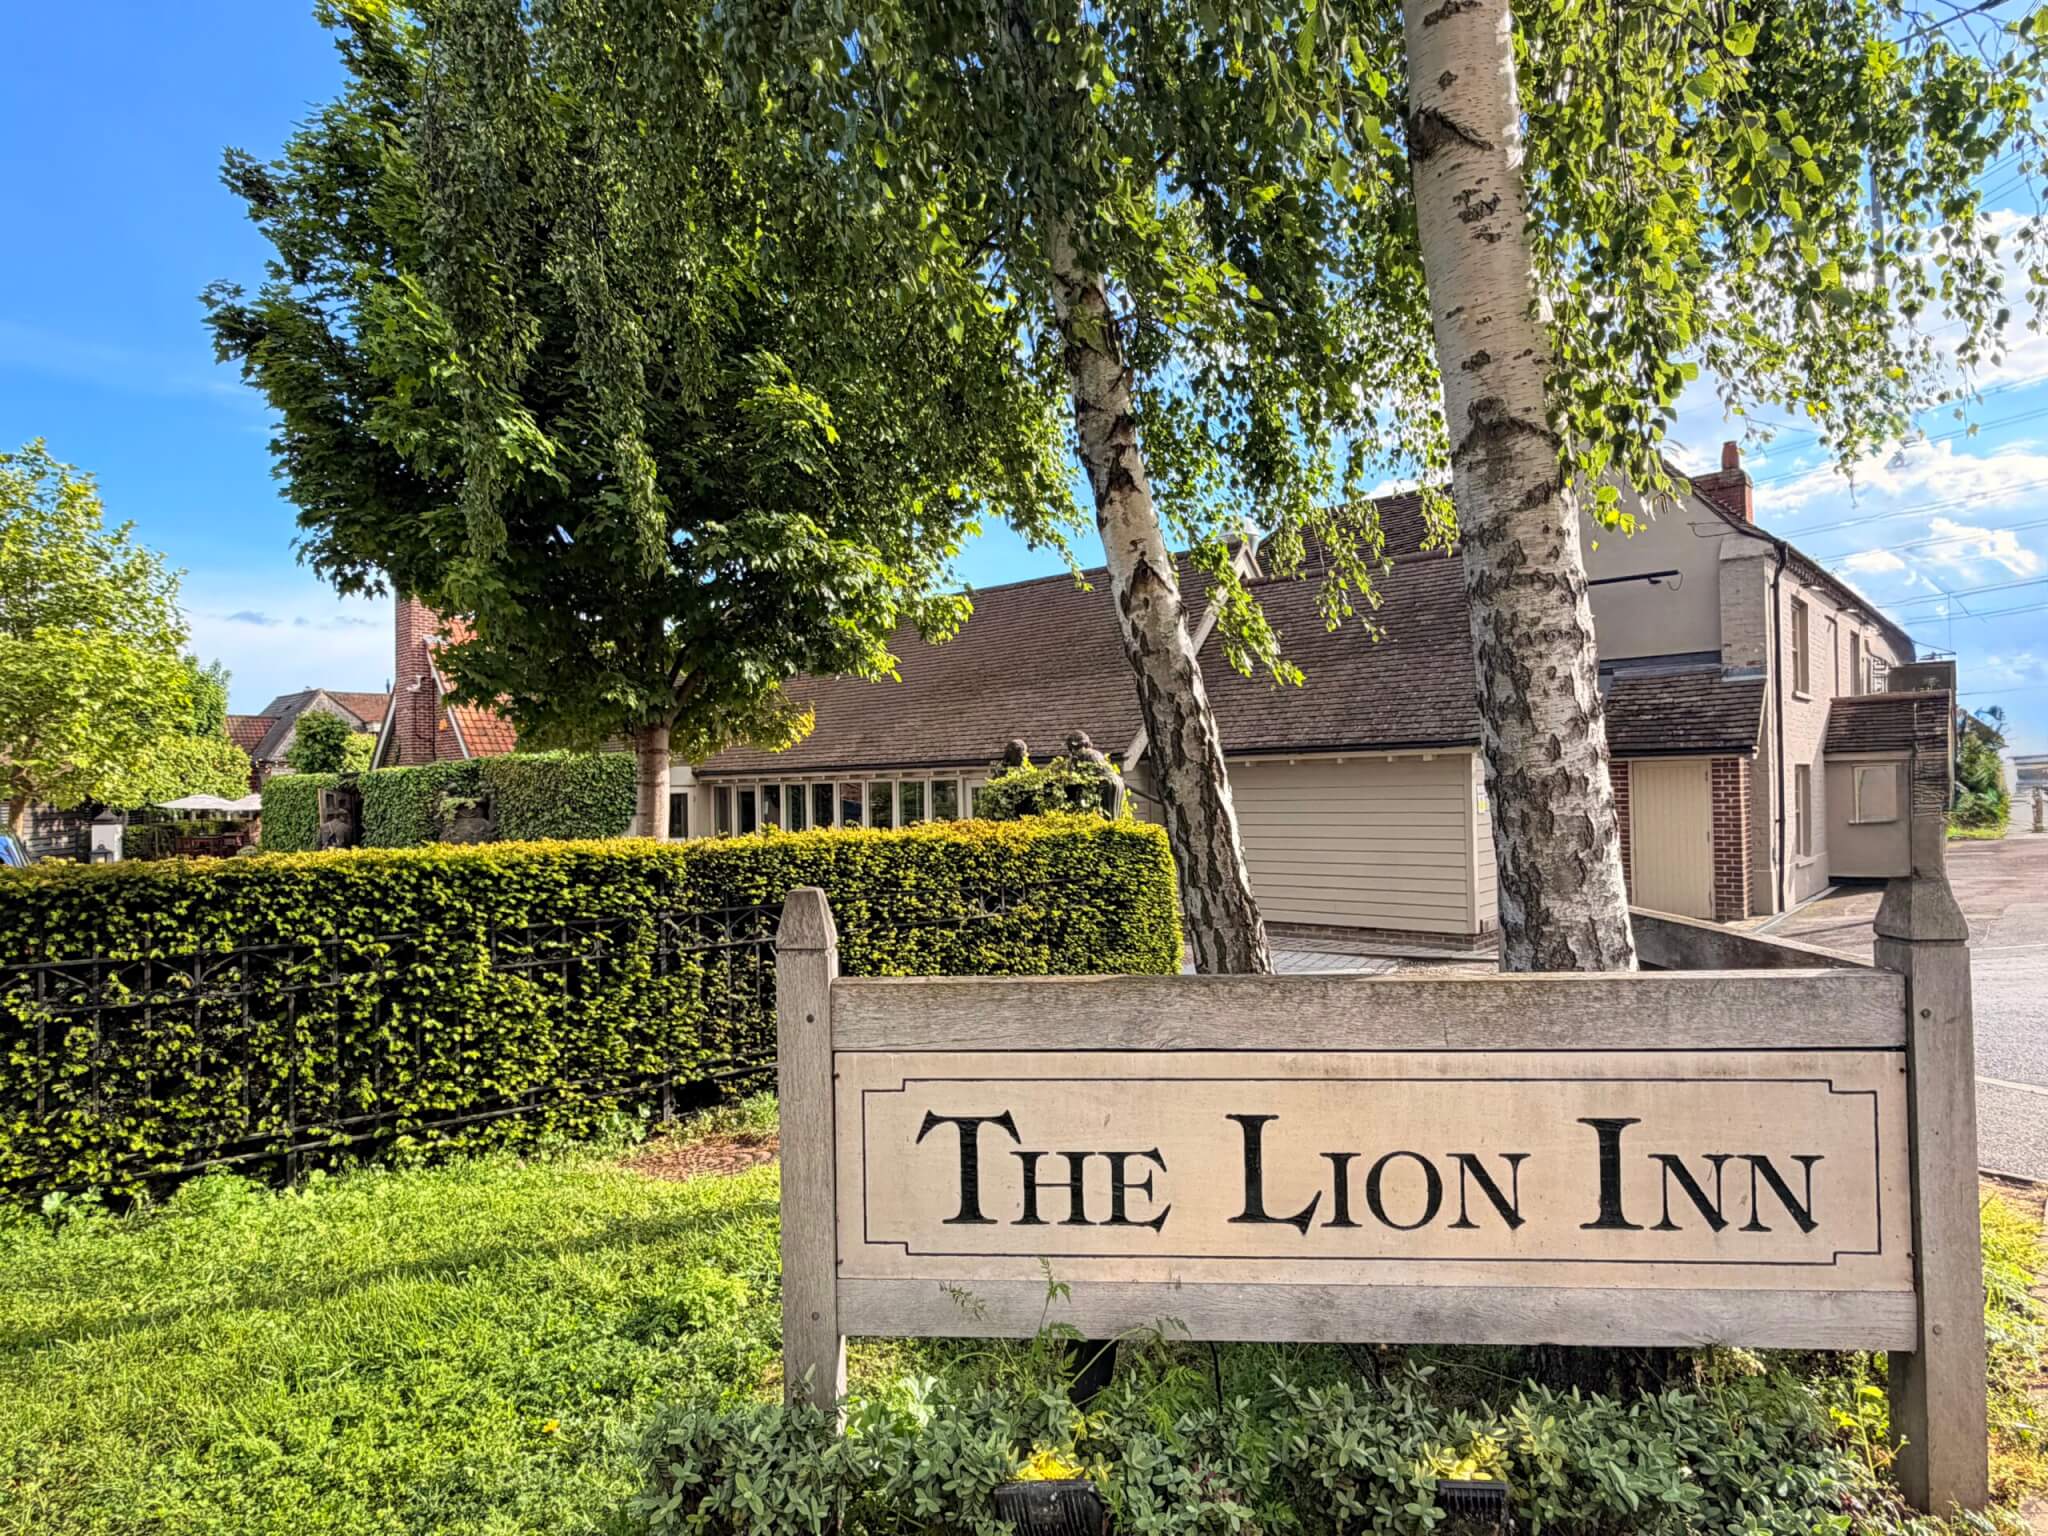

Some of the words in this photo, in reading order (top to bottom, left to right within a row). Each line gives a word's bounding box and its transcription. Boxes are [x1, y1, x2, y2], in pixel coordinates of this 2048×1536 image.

[916, 1110, 1173, 1232] THE
[1225, 1114, 1531, 1236] LION
[1577, 1117, 1826, 1234] INN
